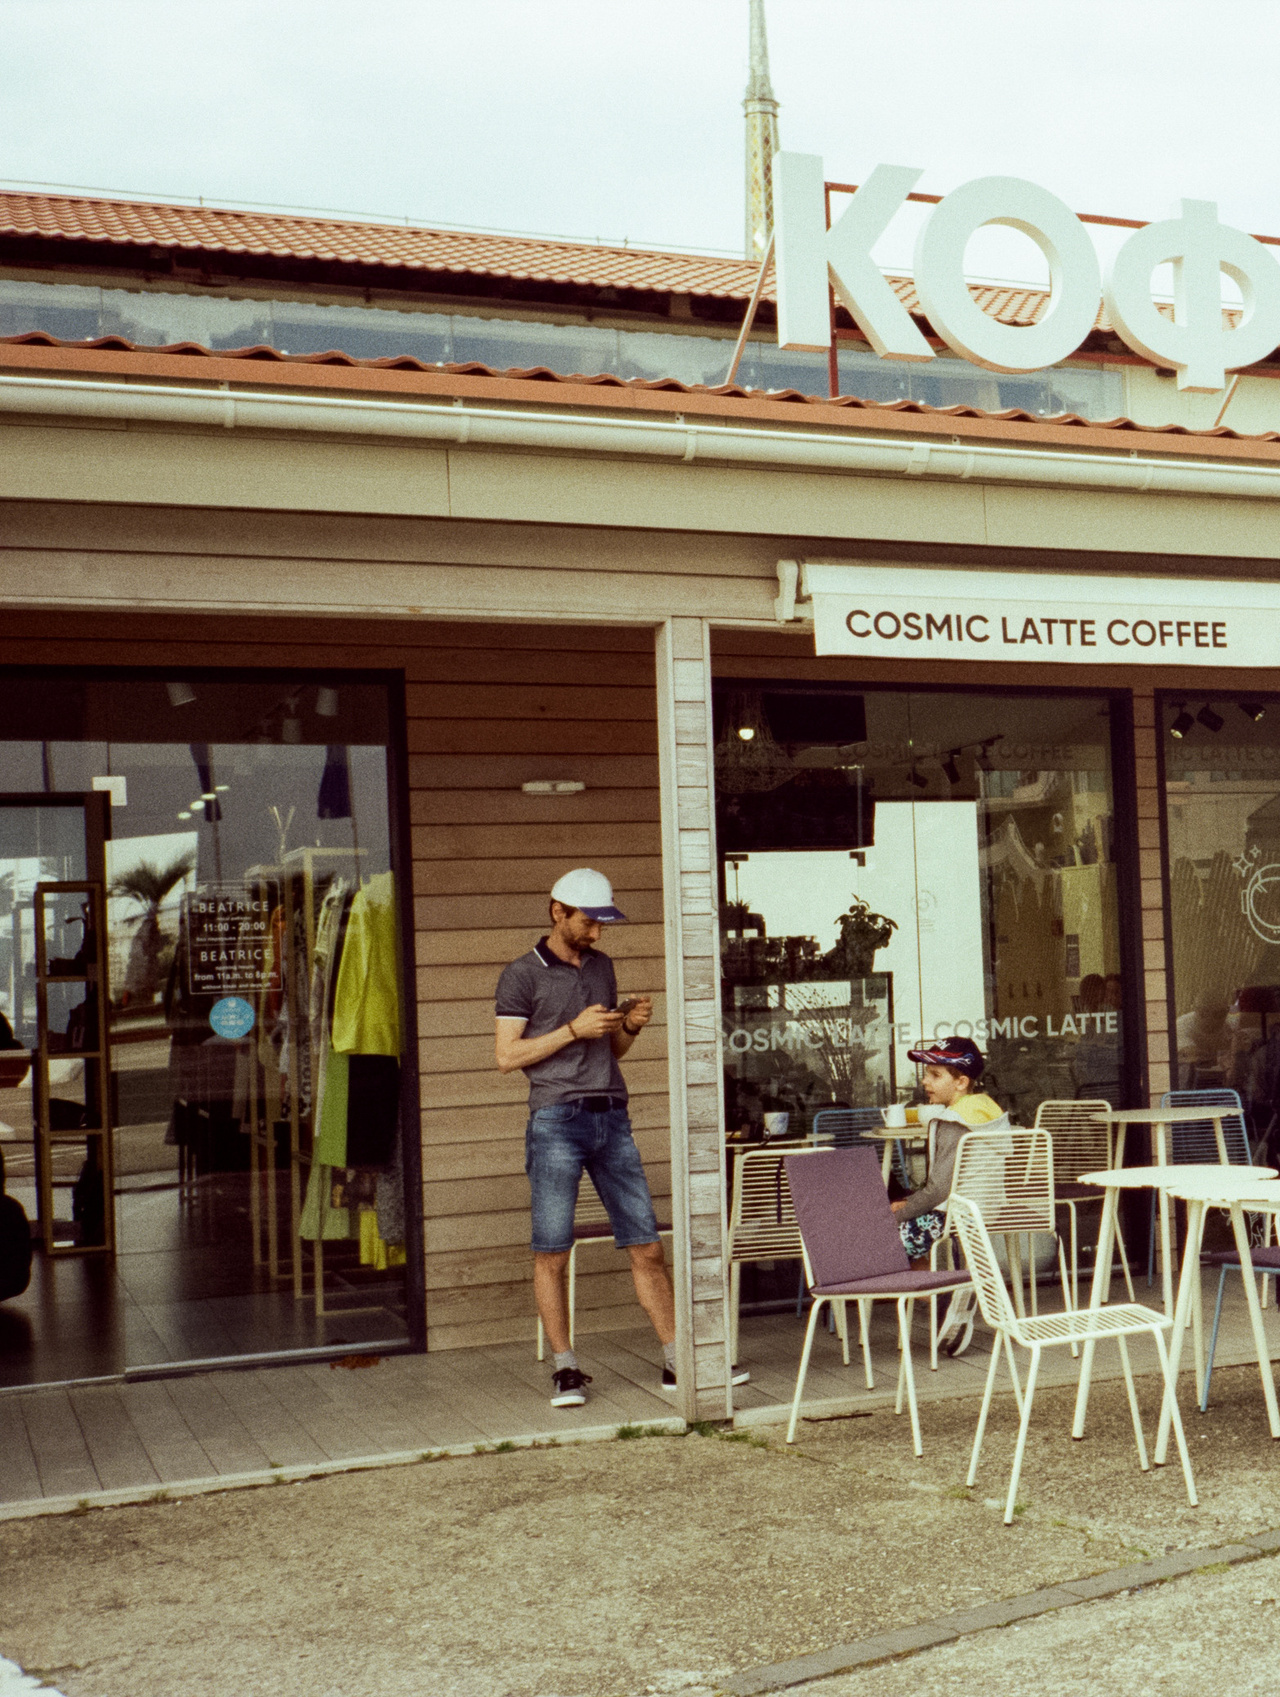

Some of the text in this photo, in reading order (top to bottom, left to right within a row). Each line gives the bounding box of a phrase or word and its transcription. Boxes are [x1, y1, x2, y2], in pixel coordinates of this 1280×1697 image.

[845, 609, 1228, 649] COSMIC LATTE COFFEE
[198, 900, 269, 913] BEATRICE
[203, 922, 229, 932] 11:00
[238, 921, 266, 931] 20:00
[200, 948, 272, 962] BEATRICE
[194, 973, 214, 981] from
[244, 971, 254, 979] to
[933, 1011, 1118, 1041] COSMIC LATTE
[832, 1021, 912, 1048] LATTE
